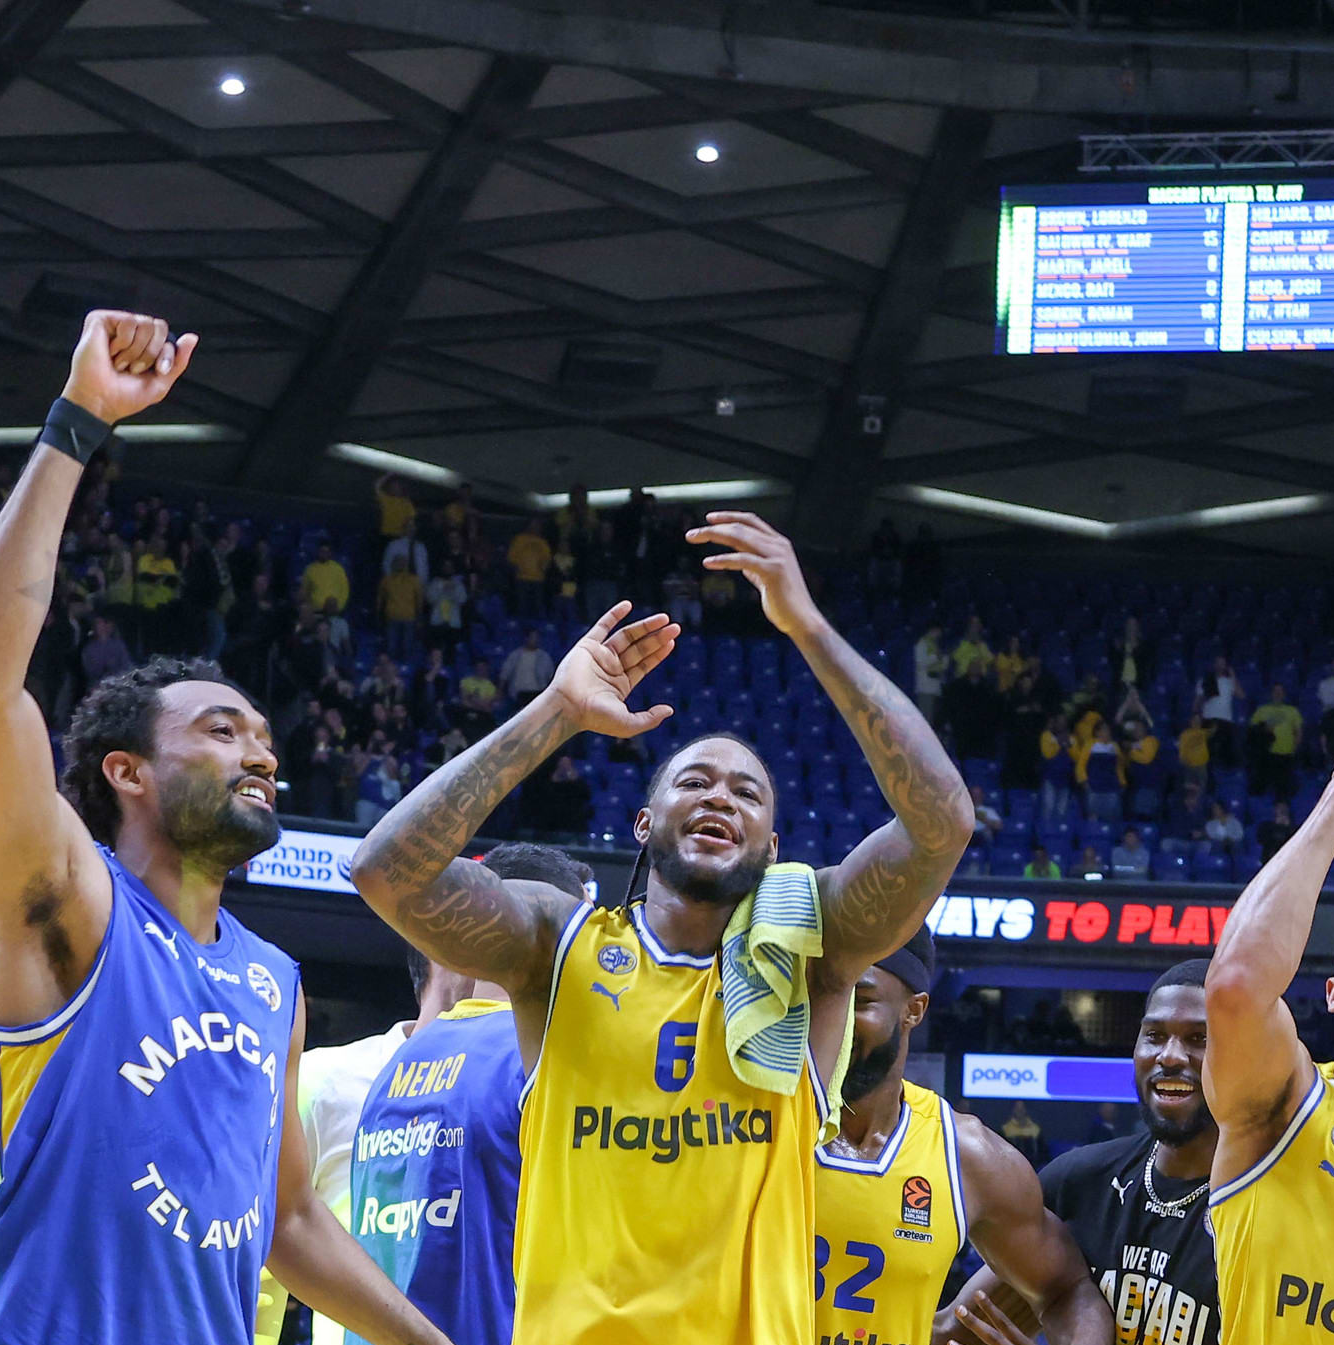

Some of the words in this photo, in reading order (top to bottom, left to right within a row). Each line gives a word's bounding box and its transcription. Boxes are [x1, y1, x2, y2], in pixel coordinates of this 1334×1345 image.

[249, 860, 332, 882] מבטחים
[272, 846, 333, 865] מנורה
[1046, 902, 1109, 941] TO
[387, 1053, 467, 1099] MENCO
[655, 1020, 696, 1092] 6
[357, 1115, 465, 1163] Investing.com
[572, 1099, 772, 1163] Playtika
[131, 1161, 191, 1243] TEL
[359, 1188, 462, 1242] Rapyd
[1145, 1200, 1186, 1219] Playtika
[894, 1229, 933, 1242] oneteam
[1122, 1244, 1150, 1271] WE
